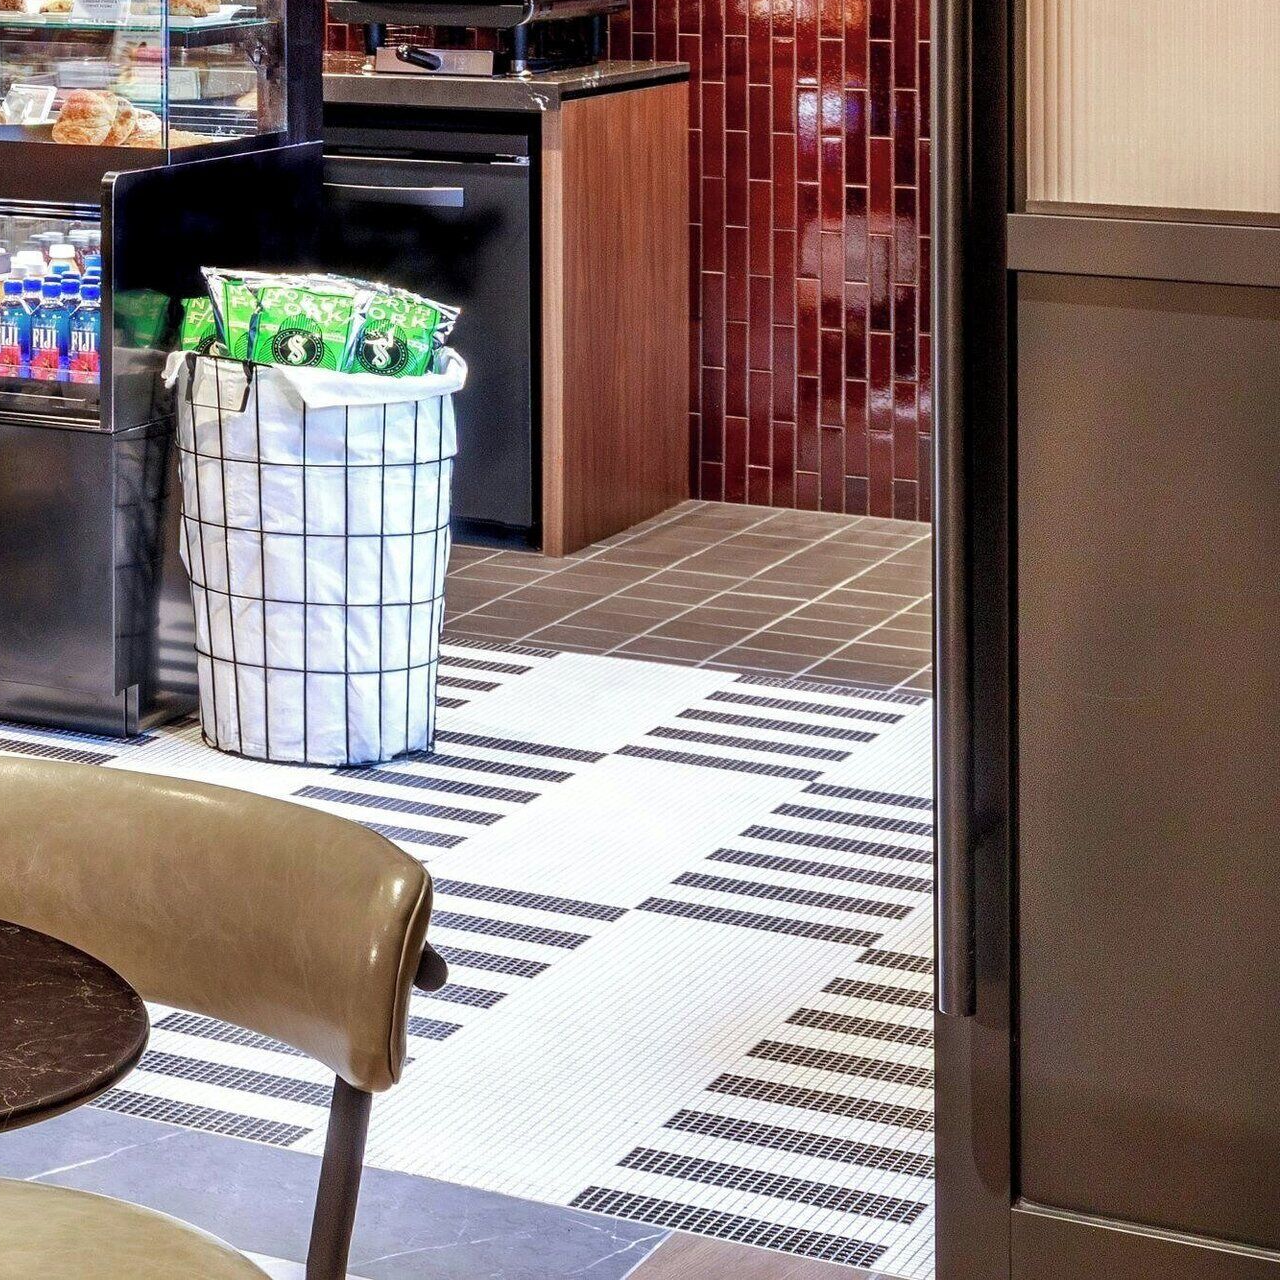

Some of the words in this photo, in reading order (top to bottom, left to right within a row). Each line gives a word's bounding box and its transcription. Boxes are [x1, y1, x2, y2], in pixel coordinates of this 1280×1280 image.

[372, 293, 431, 317] ORTH
[368, 307, 428, 329] ORK
[32, 327, 57, 349] FIJI
[71, 330, 95, 352] FIJI
